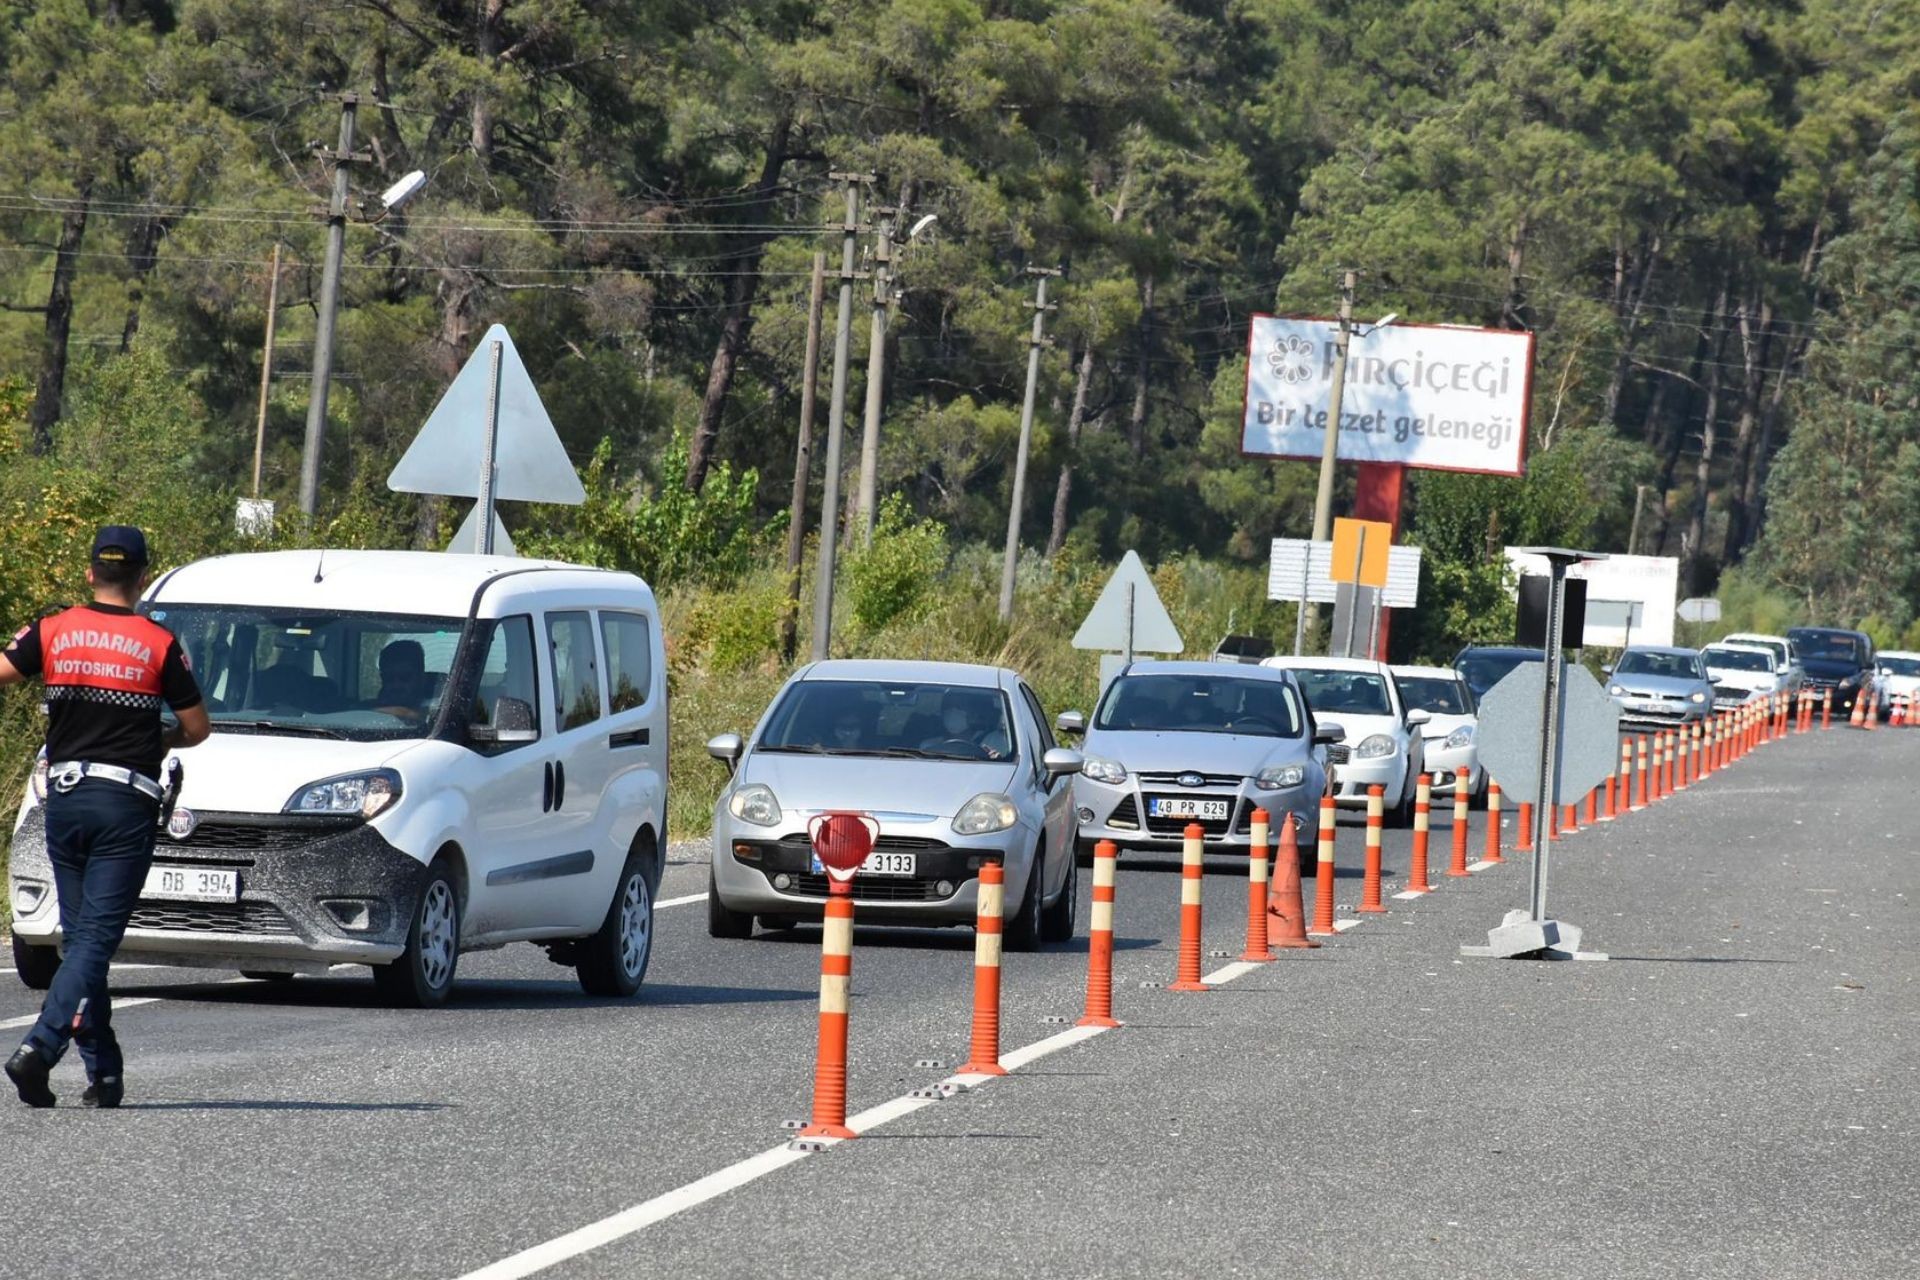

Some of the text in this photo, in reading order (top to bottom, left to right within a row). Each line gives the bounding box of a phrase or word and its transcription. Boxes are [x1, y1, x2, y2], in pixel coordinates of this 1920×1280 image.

[1257, 401, 1296, 426] Bir
[1394, 414, 1513, 450] geleneği
[51, 630, 152, 664] JANDARMA
[1158, 801, 1172, 813] 48
[1180, 801, 1195, 813] PR
[1203, 802, 1225, 815] 629
[874, 855, 912, 872] 3133
[162, 871, 231, 893] DB 394
